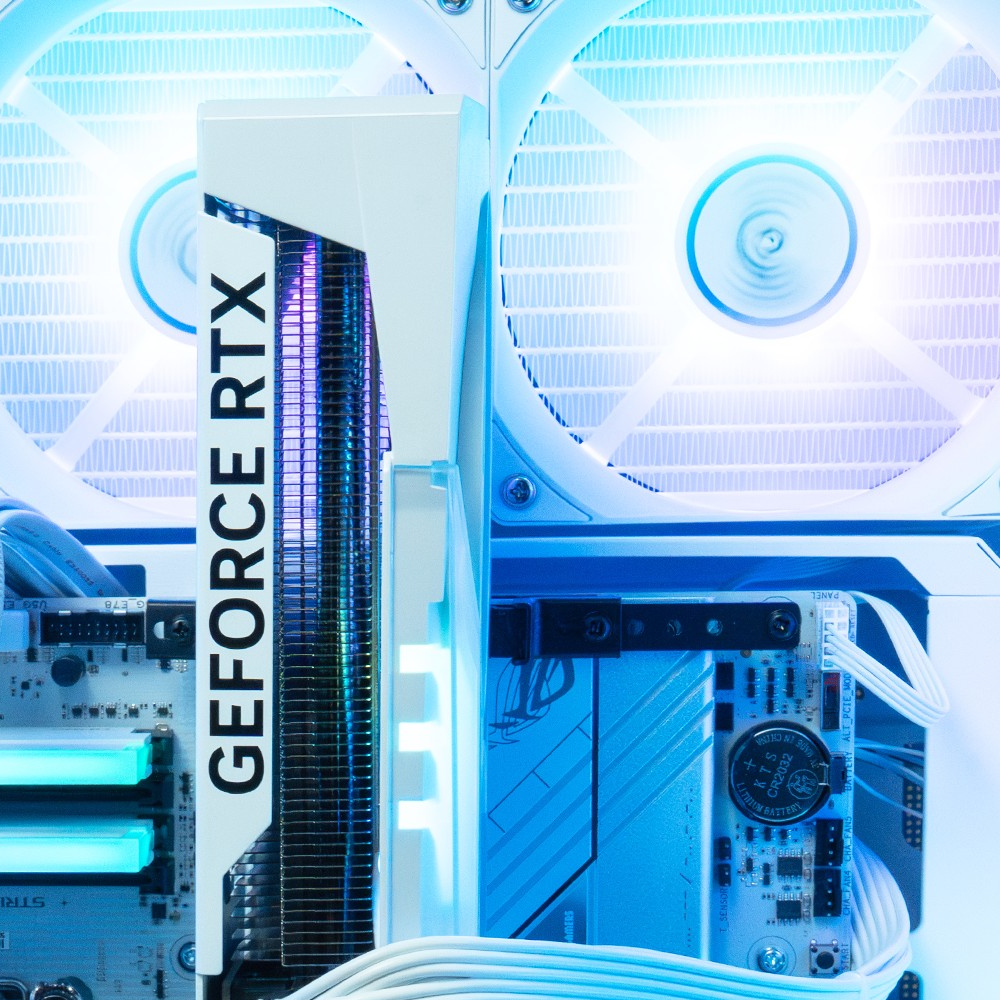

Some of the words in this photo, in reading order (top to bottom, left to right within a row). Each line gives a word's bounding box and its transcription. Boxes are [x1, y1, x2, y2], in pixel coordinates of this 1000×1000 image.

[210, 271, 266, 419] RTX
[104, 598, 145, 609] G_E78
[208, 446, 266, 795] GEFORCE
[842, 672, 854, 742] ALT_PCIE_MOD
[767, 753, 793, 798] CR2032
[736, 782, 764, 813] LITHIUM
[764, 802, 802, 816] BATTERY
[843, 816, 852, 861] CHA_FAN5
[564, 911, 574, 943] AMERS
